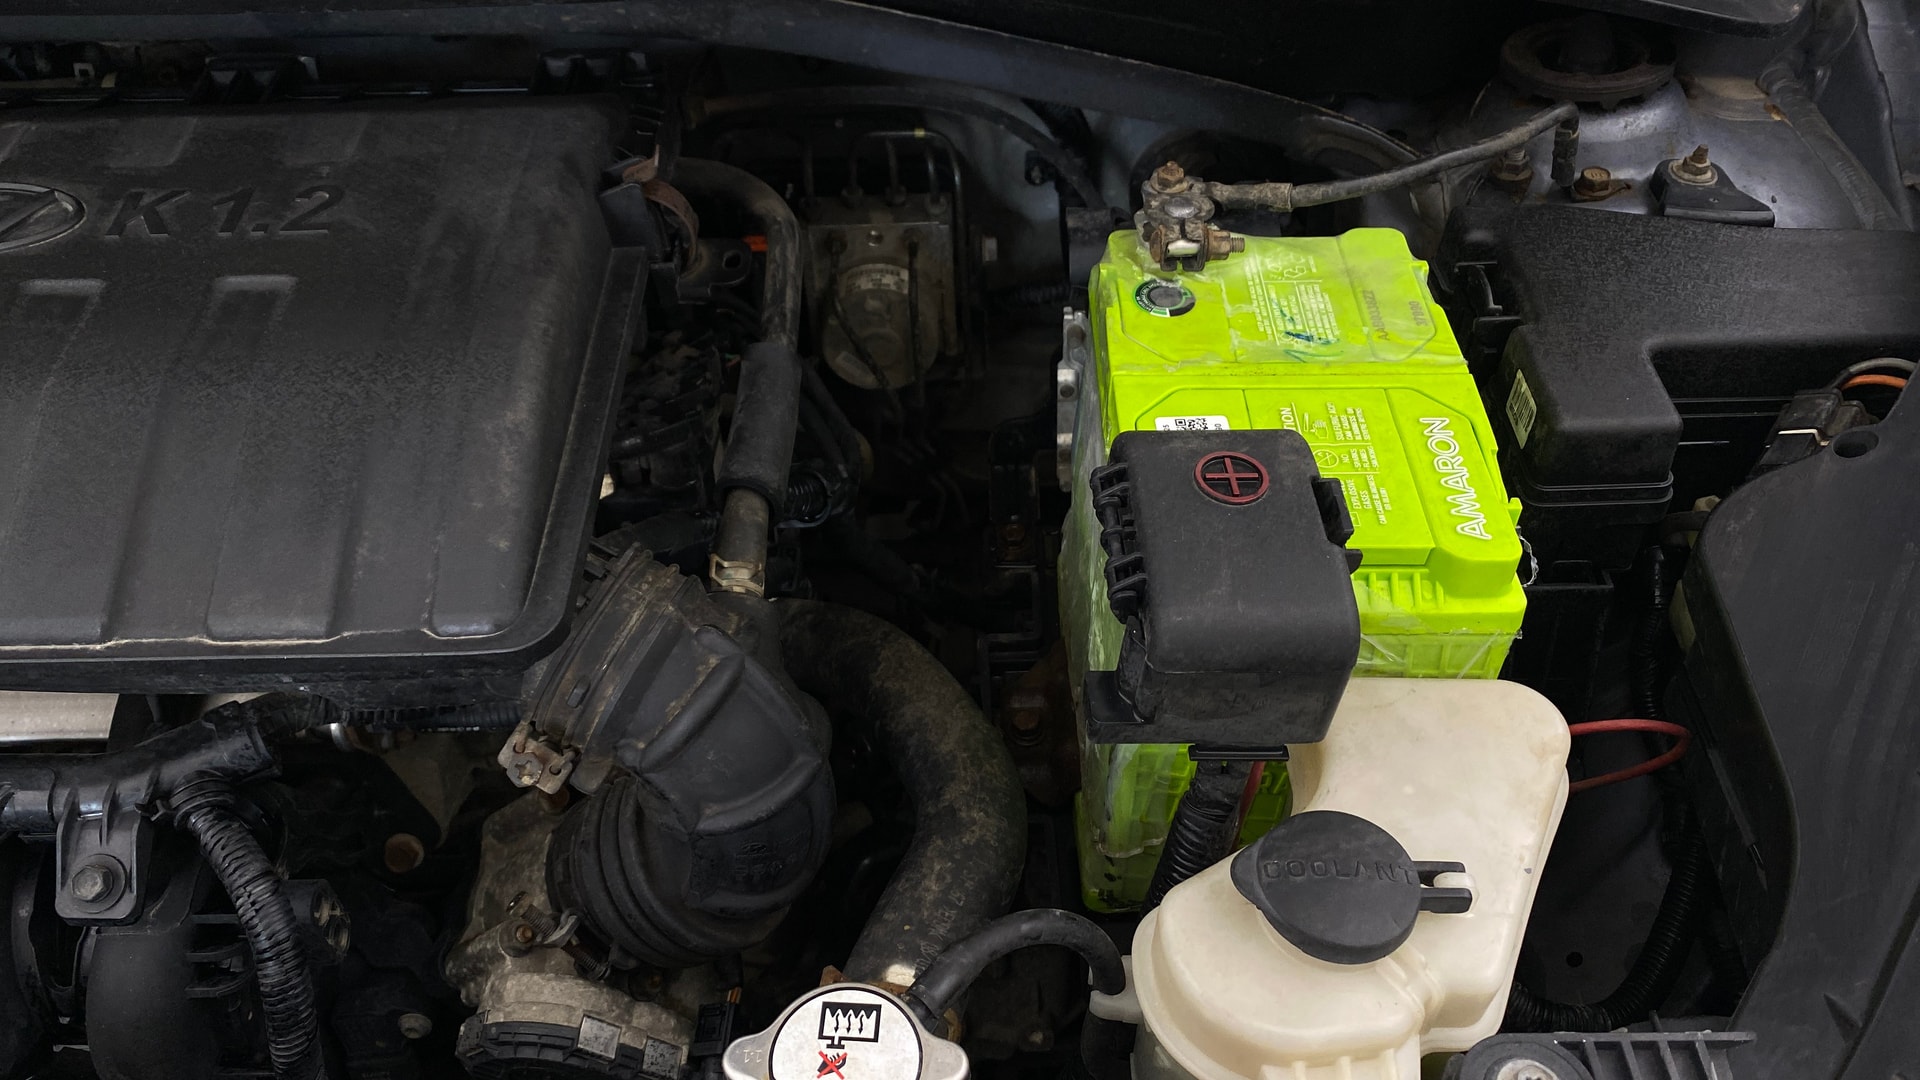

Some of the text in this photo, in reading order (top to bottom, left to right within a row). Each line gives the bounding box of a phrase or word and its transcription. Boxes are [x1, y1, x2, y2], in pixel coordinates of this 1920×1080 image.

[103, 184, 345, 238] K 1.2
[1279, 407, 1296, 430] TION
[1419, 417, 1492, 540] AMARON
[1344, 479, 1363, 509] EXPLOSIVE
[1358, 490, 1373, 509] GASES
[1263, 860, 1413, 885] COOLANT
